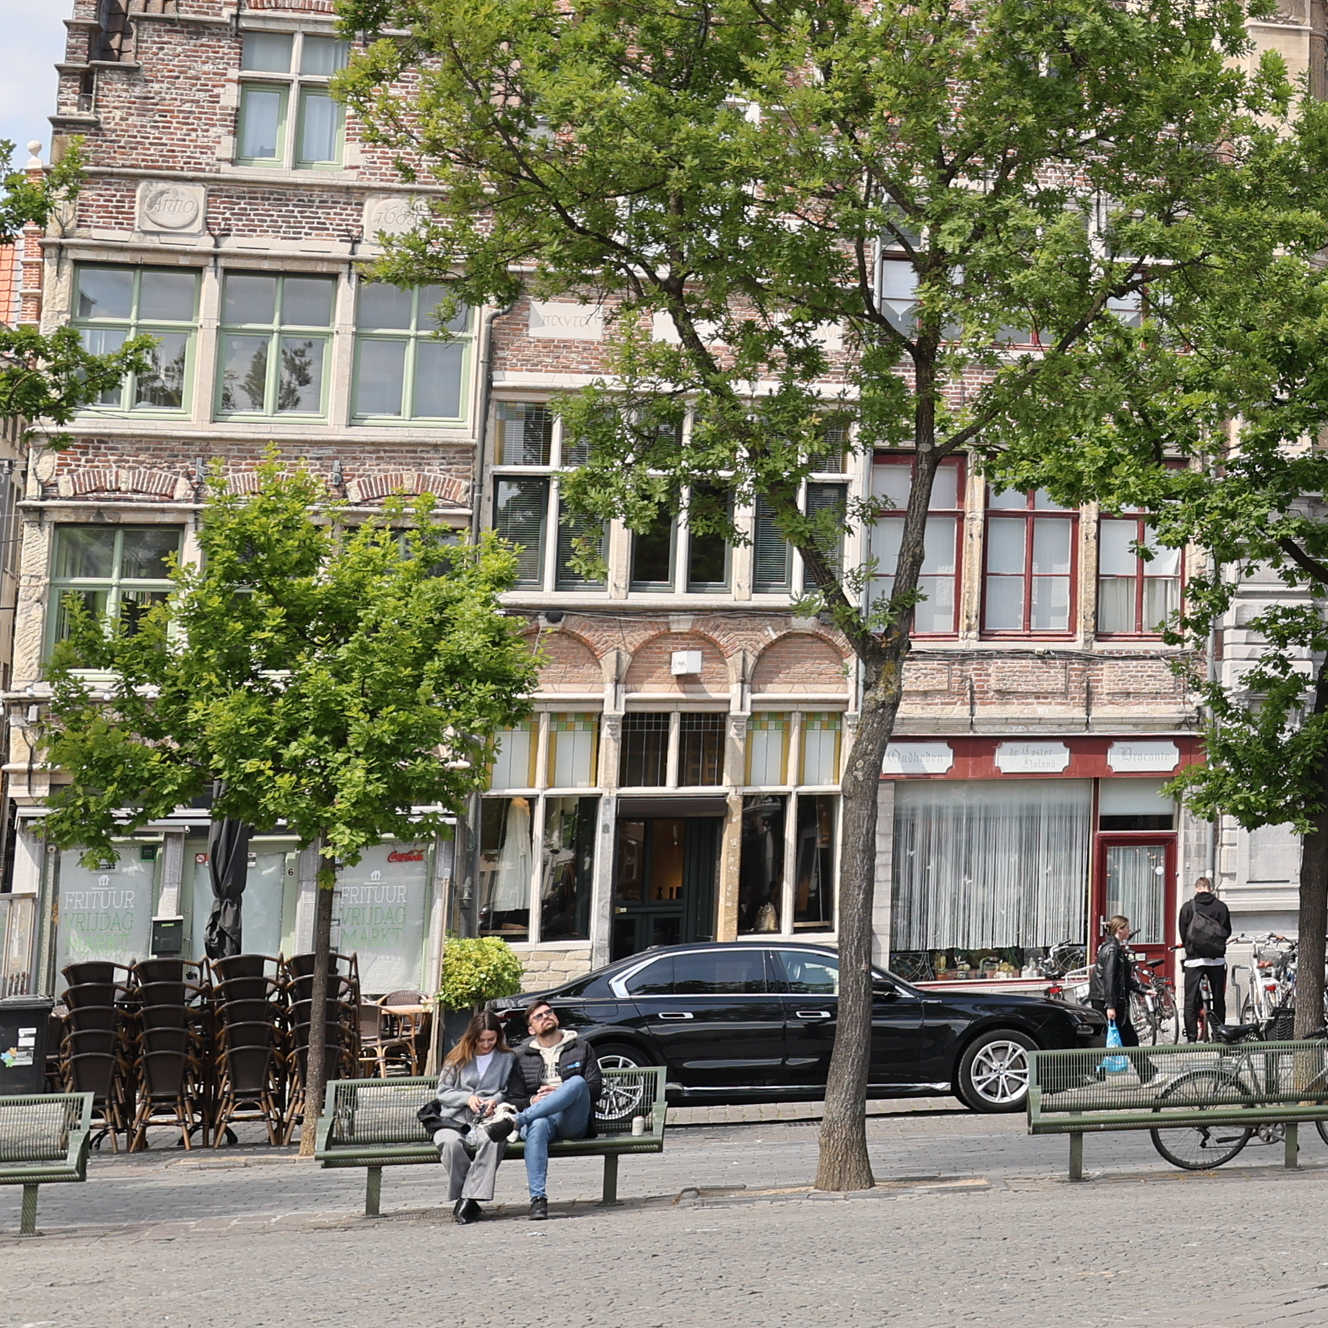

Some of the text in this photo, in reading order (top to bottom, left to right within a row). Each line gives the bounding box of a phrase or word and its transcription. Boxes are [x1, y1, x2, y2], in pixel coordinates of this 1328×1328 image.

[288, 868, 293, 877] 6
[64, 890, 136, 909] FRITUUR
[340, 885, 407, 904] FRITUUR
[64, 912, 136, 932] VRIJDAG
[340, 905, 407, 926] VRIJDAG
